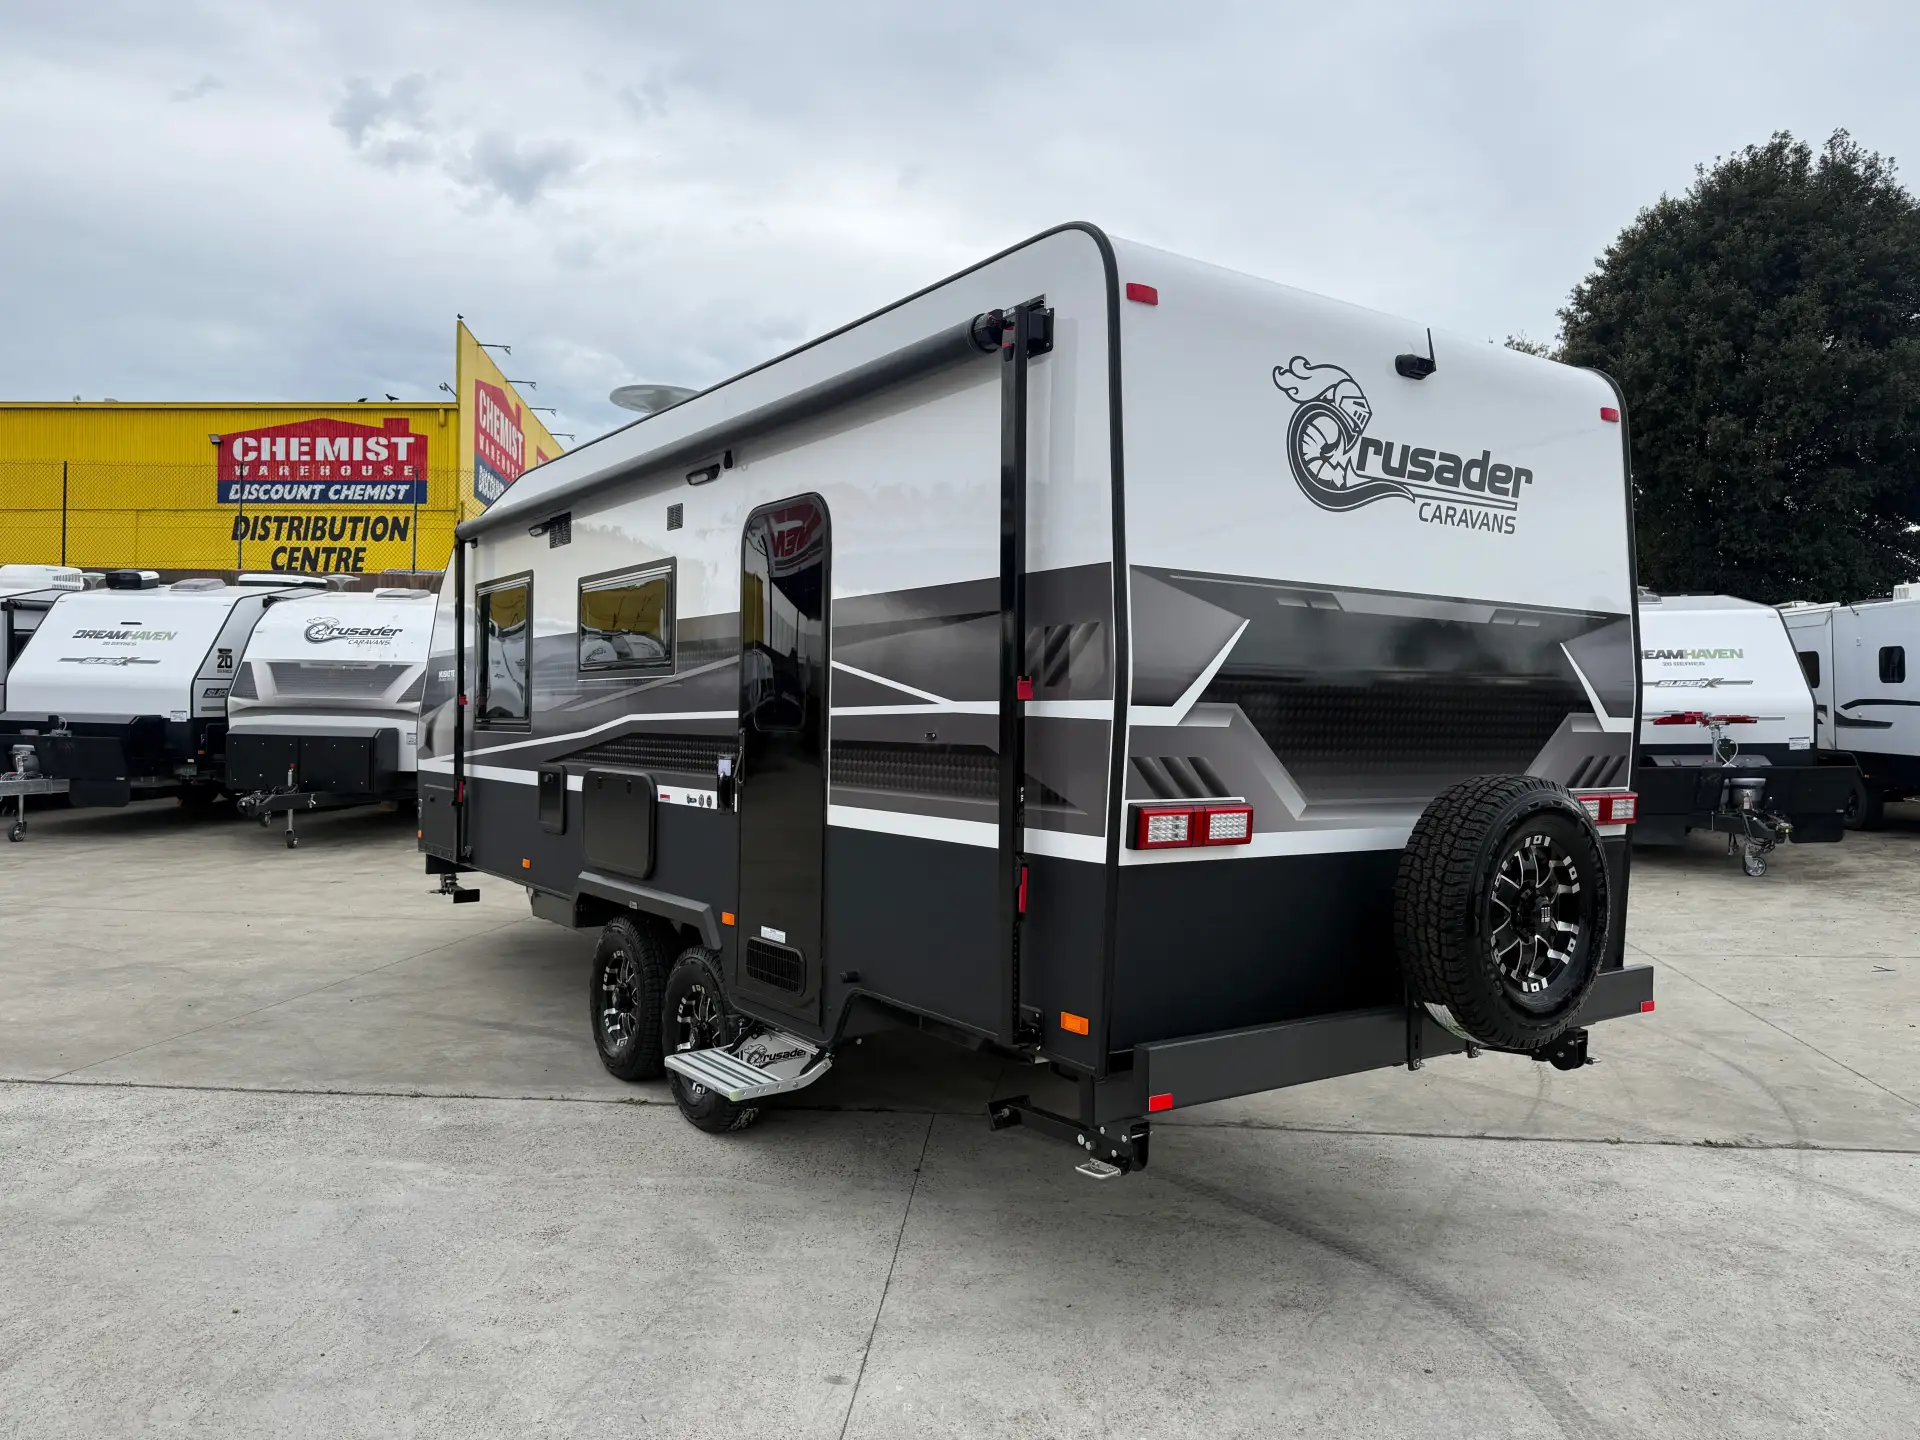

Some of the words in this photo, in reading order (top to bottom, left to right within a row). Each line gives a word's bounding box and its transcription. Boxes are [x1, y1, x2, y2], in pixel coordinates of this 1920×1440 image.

[479, 389, 523, 466] CHEMIST
[232, 436, 415, 462] CHEMIST
[479, 432, 520, 478] WAREHOUS
[234, 465, 413, 476] WAREHOUSE
[228, 484, 326, 500] DISCOUNT
[328, 484, 410, 500] CHEMIST
[231, 515, 410, 541] DISTRIBUTION
[1418, 502, 1517, 534] CARAVANS
[271, 546, 367, 573] CENTRE
[72, 629, 178, 641] DREAMHAVEN
[217, 654, 233, 669] 20
[1641, 648, 1744, 660] EAMHAVEN
